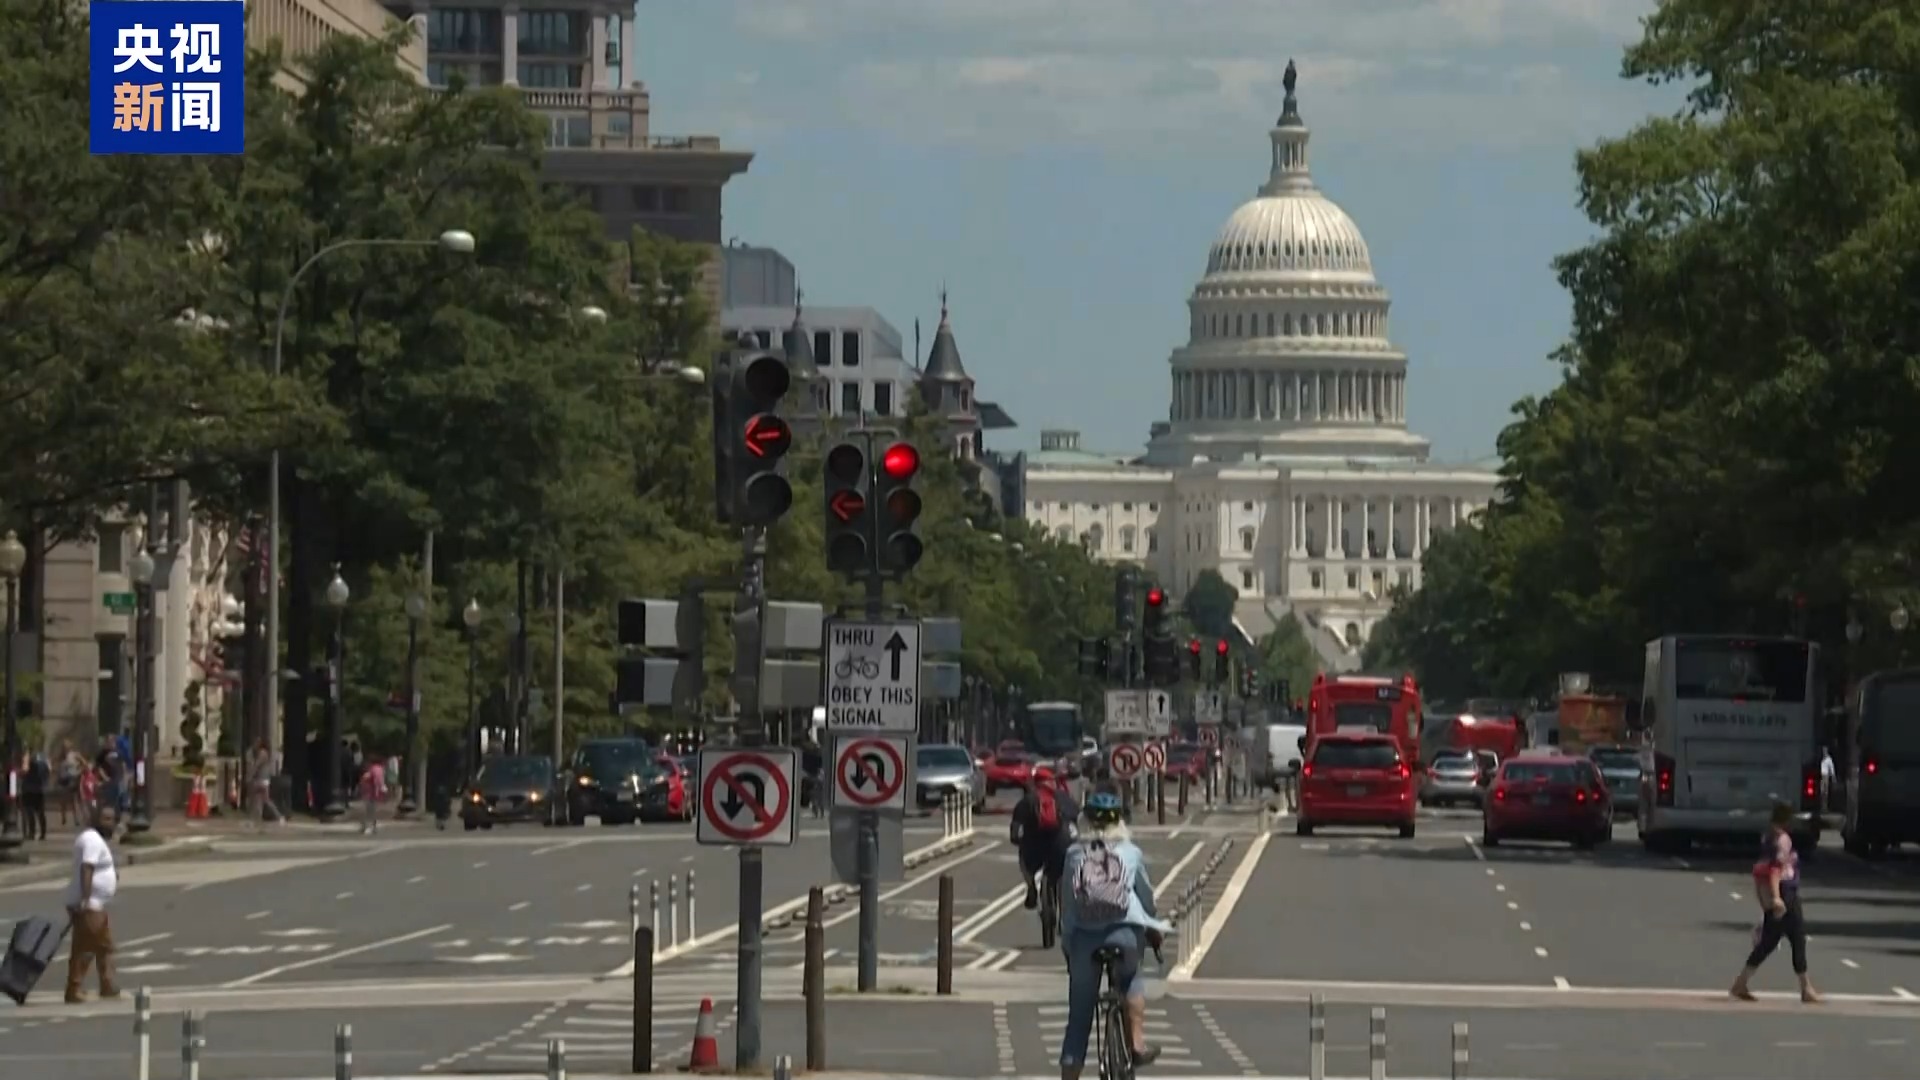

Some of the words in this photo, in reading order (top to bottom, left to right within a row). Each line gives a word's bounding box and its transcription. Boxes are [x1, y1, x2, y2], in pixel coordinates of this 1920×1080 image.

[835, 628, 874, 646] THRU
[832, 686, 872, 704] OBEY
[880, 686, 913, 705] THIS
[832, 707, 886, 725] SIGNAL
